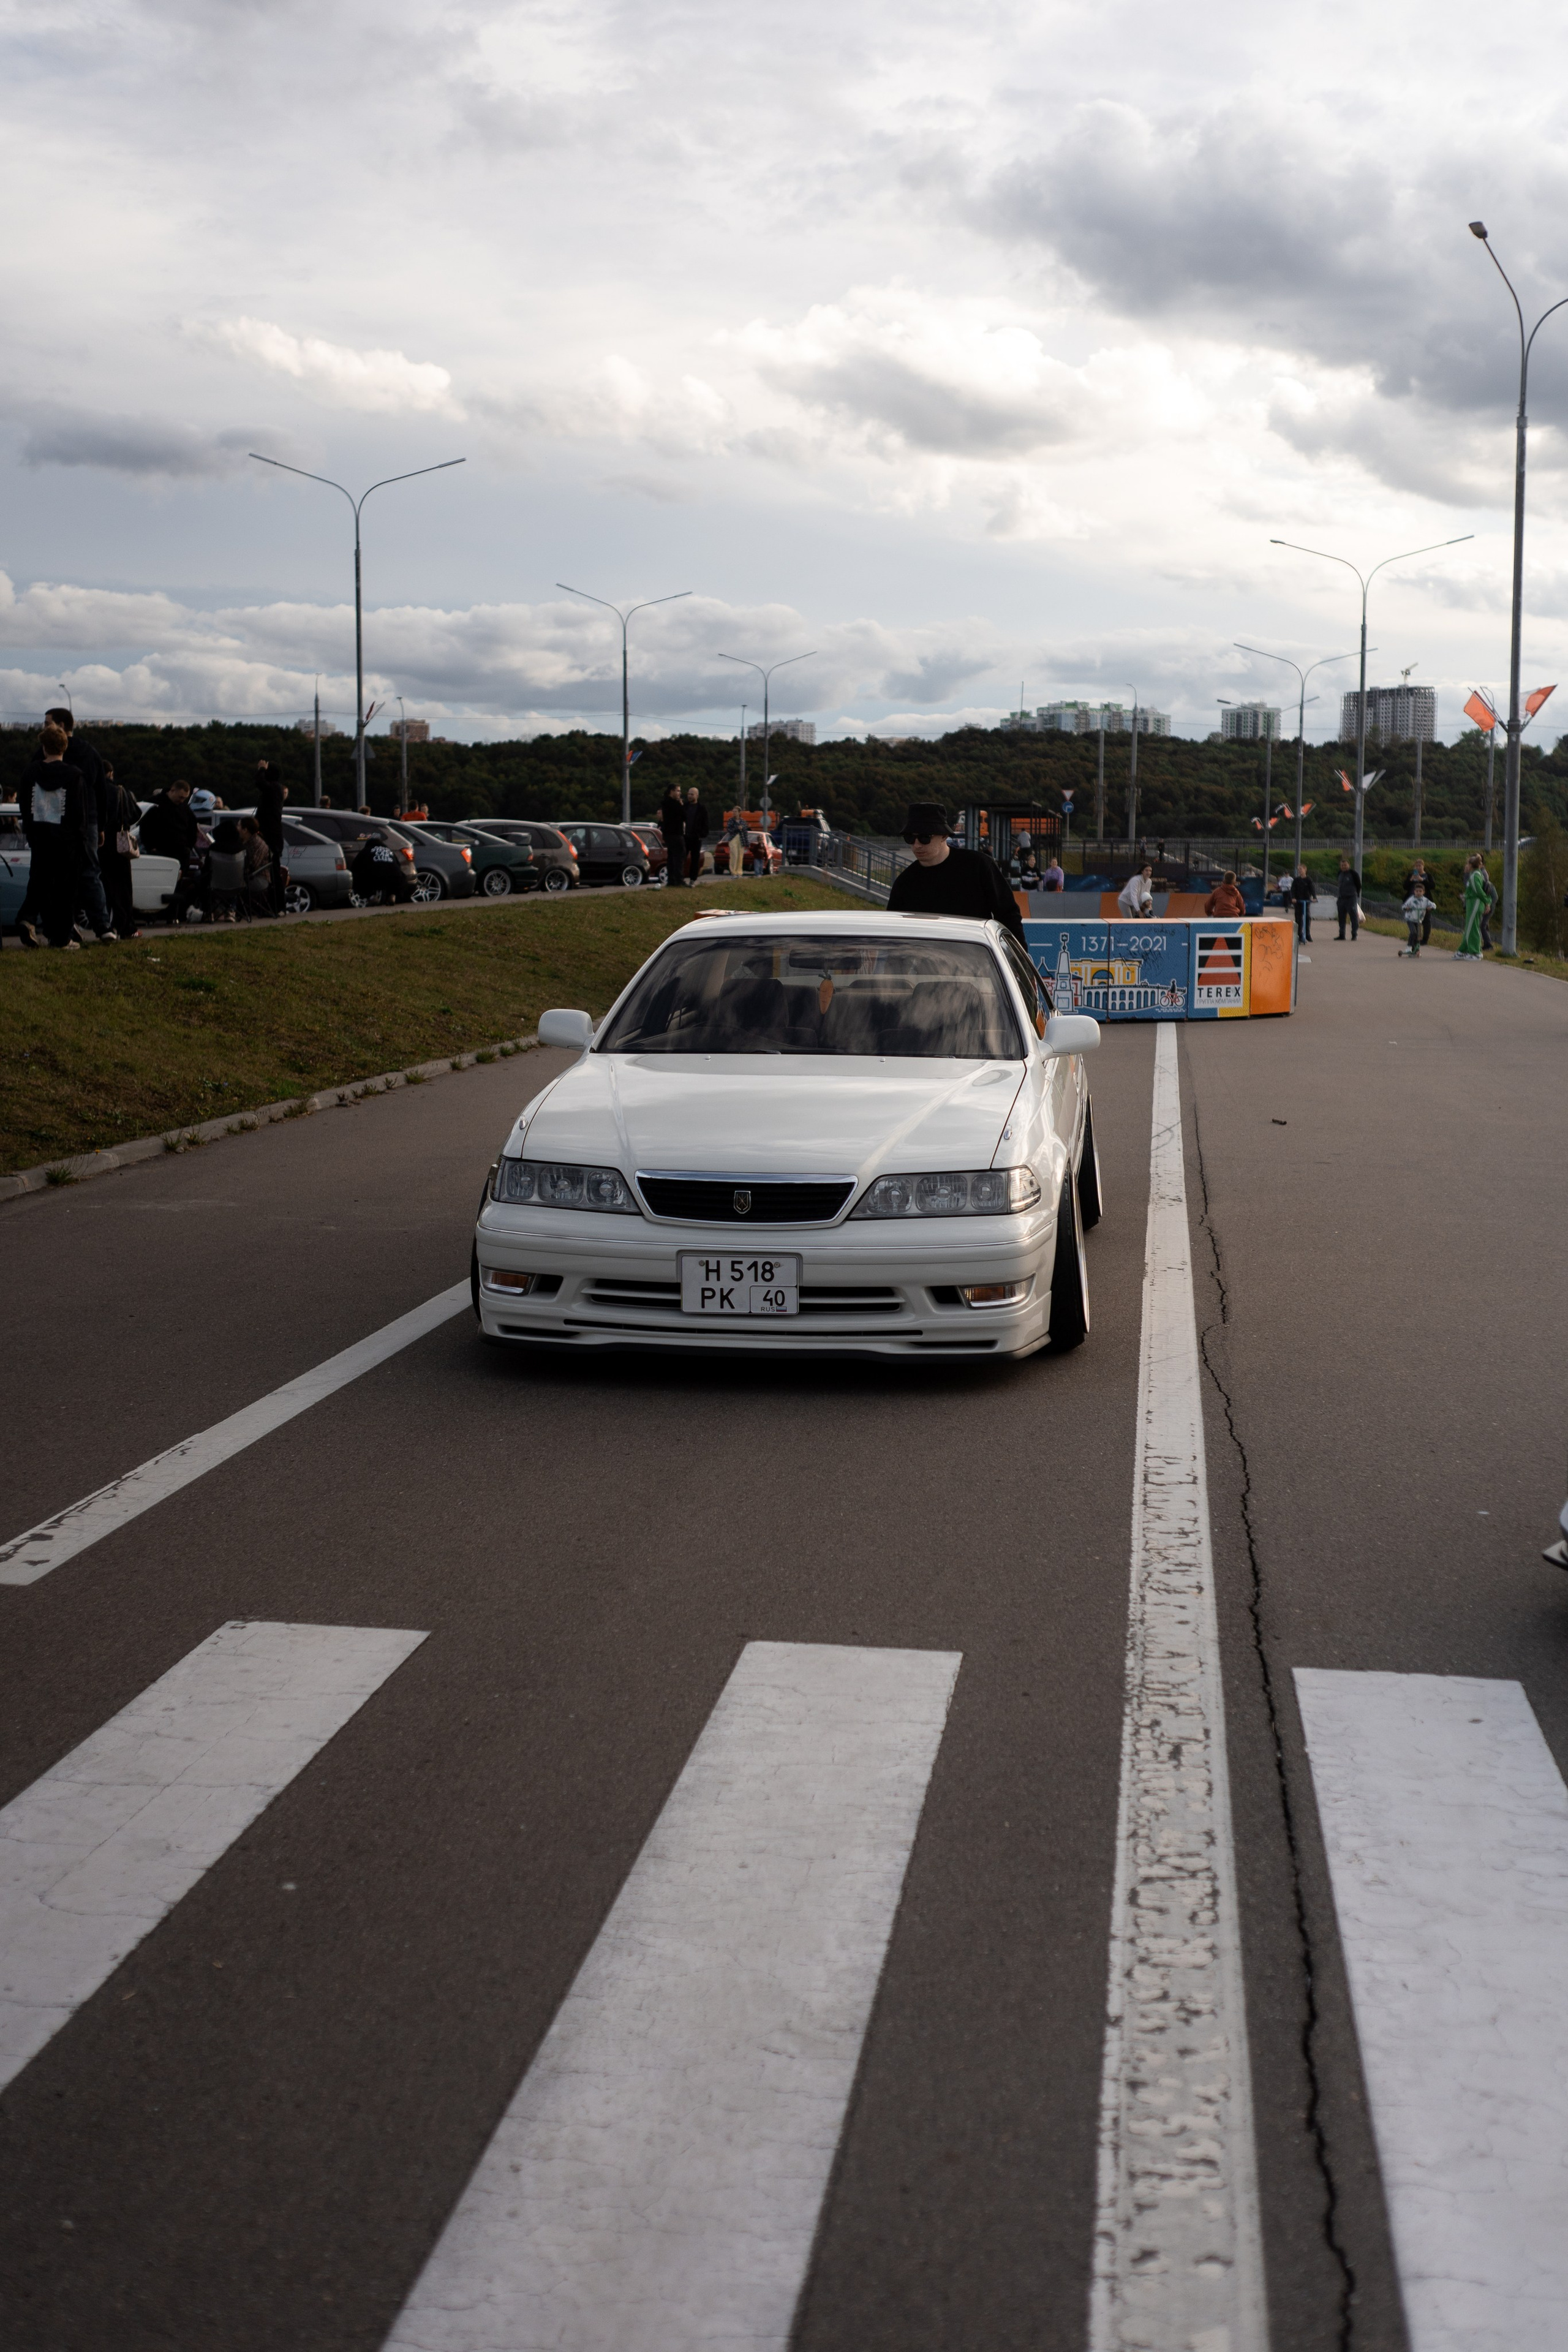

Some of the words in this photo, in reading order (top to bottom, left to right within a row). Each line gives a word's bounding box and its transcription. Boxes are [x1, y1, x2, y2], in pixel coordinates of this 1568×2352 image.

[1197, 987, 1241, 998] TEREX
[730, 1260, 775, 1282] 518
[763, 1289, 785, 1306] 40
